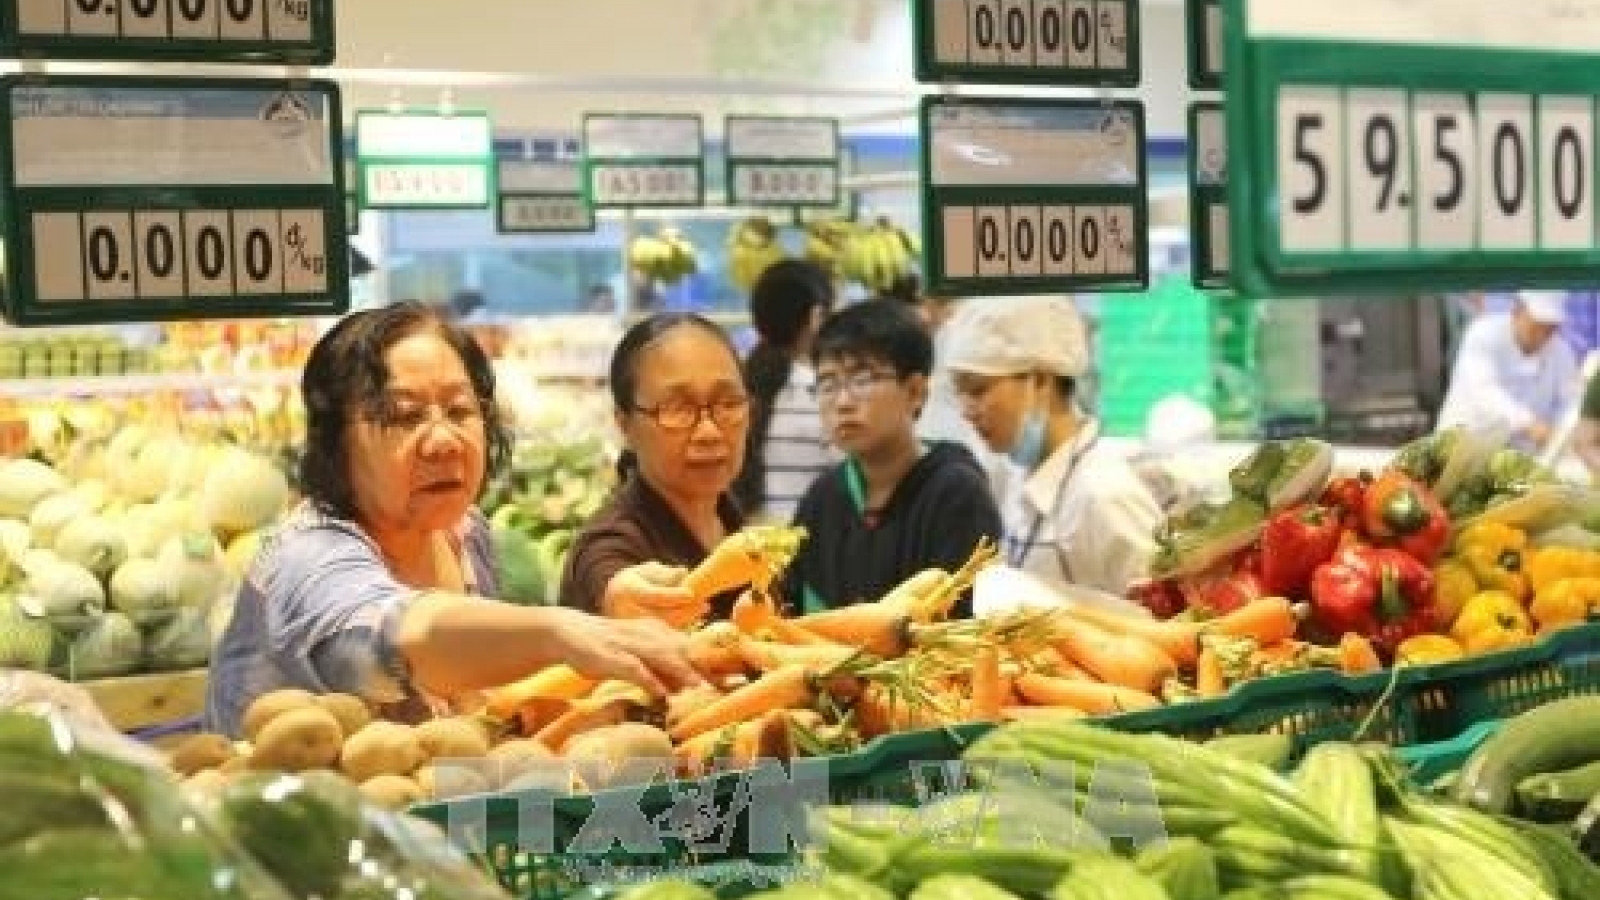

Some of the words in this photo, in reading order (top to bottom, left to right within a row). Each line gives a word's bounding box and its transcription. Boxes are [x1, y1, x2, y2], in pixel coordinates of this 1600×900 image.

[975, 7, 1087, 52] 0.000
[1292, 112, 1585, 220] 59.500
[88, 223, 273, 283] 0.000
[978, 214, 1099, 263] 0.000
